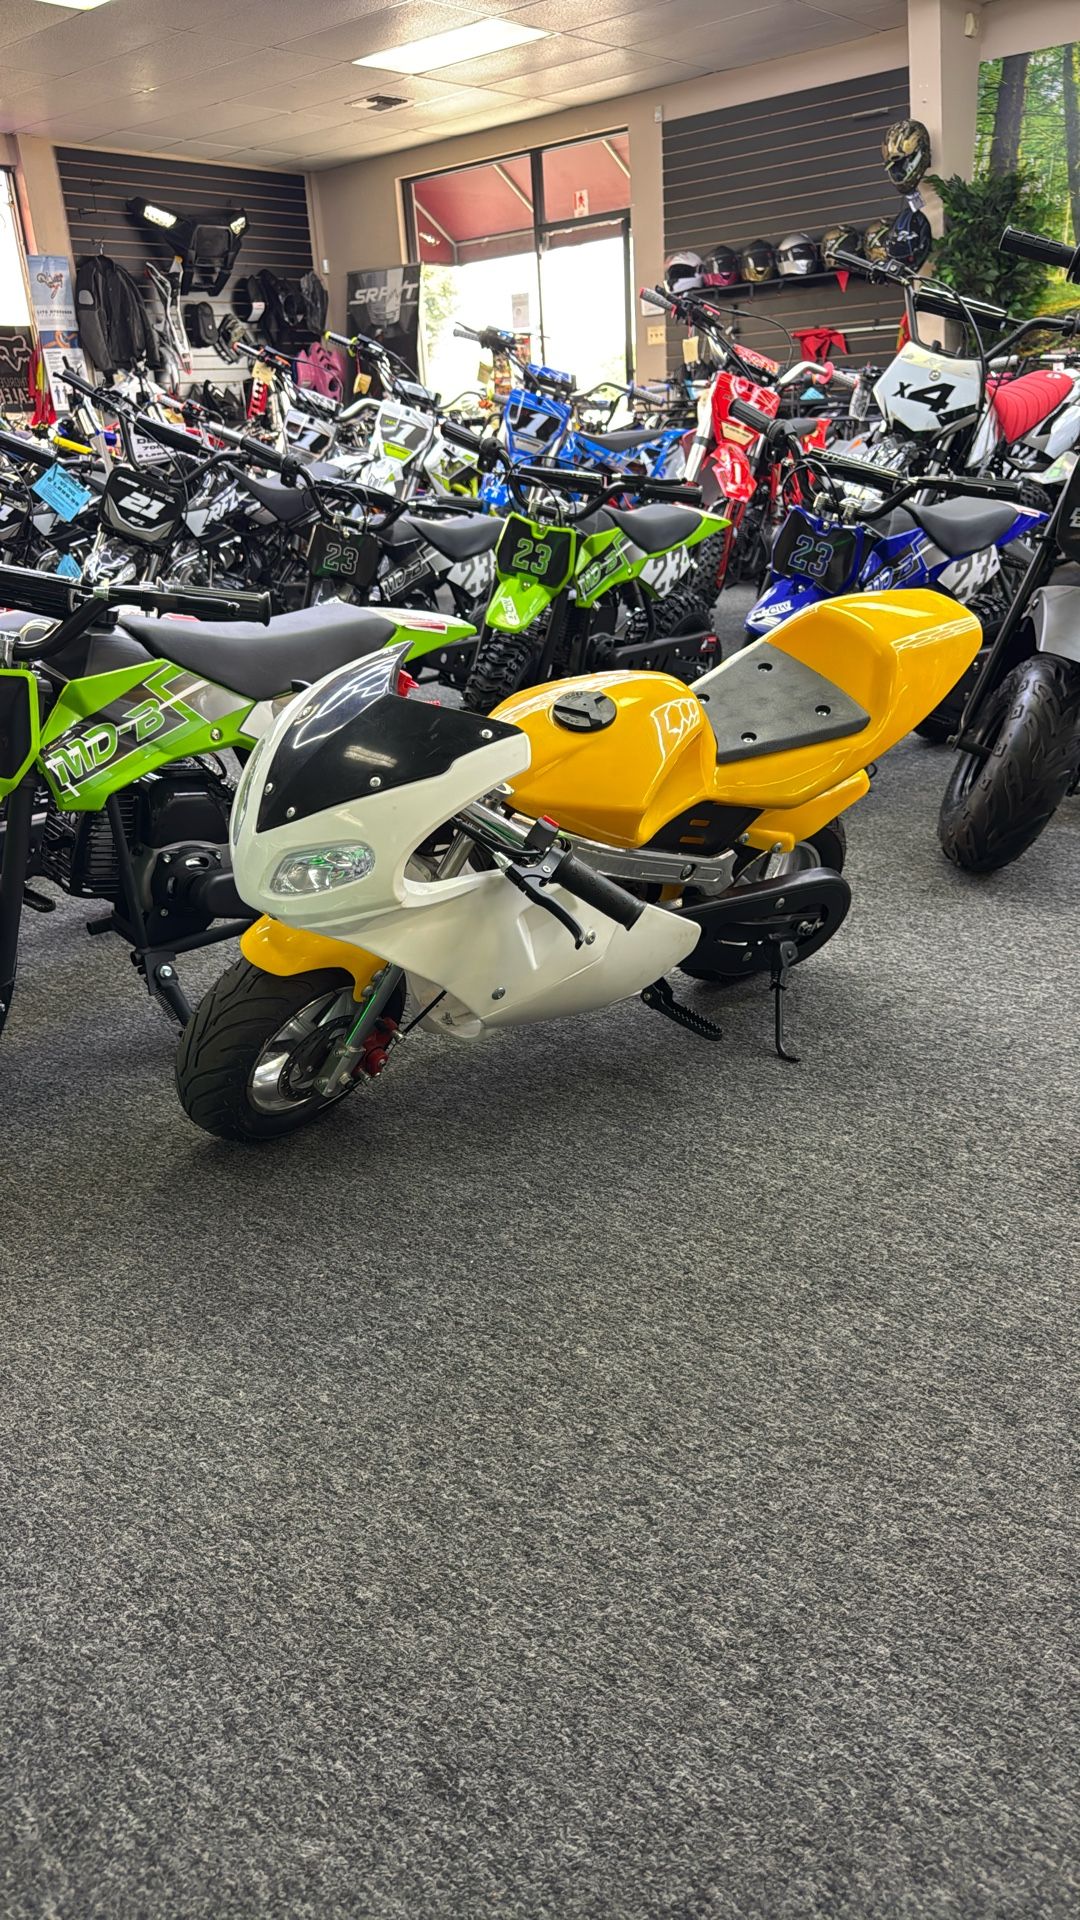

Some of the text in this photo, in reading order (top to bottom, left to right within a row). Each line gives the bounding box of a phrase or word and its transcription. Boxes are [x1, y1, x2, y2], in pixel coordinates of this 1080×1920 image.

[518, 413, 549, 438] 1
[118, 491, 166, 520] 21
[205, 488, 239, 525] RFZ
[323, 542, 359, 575] 23
[458, 551, 493, 593] 23
[512, 537, 552, 576] 23
[788, 534, 834, 577] 23
[47, 697, 166, 786] MD-B
